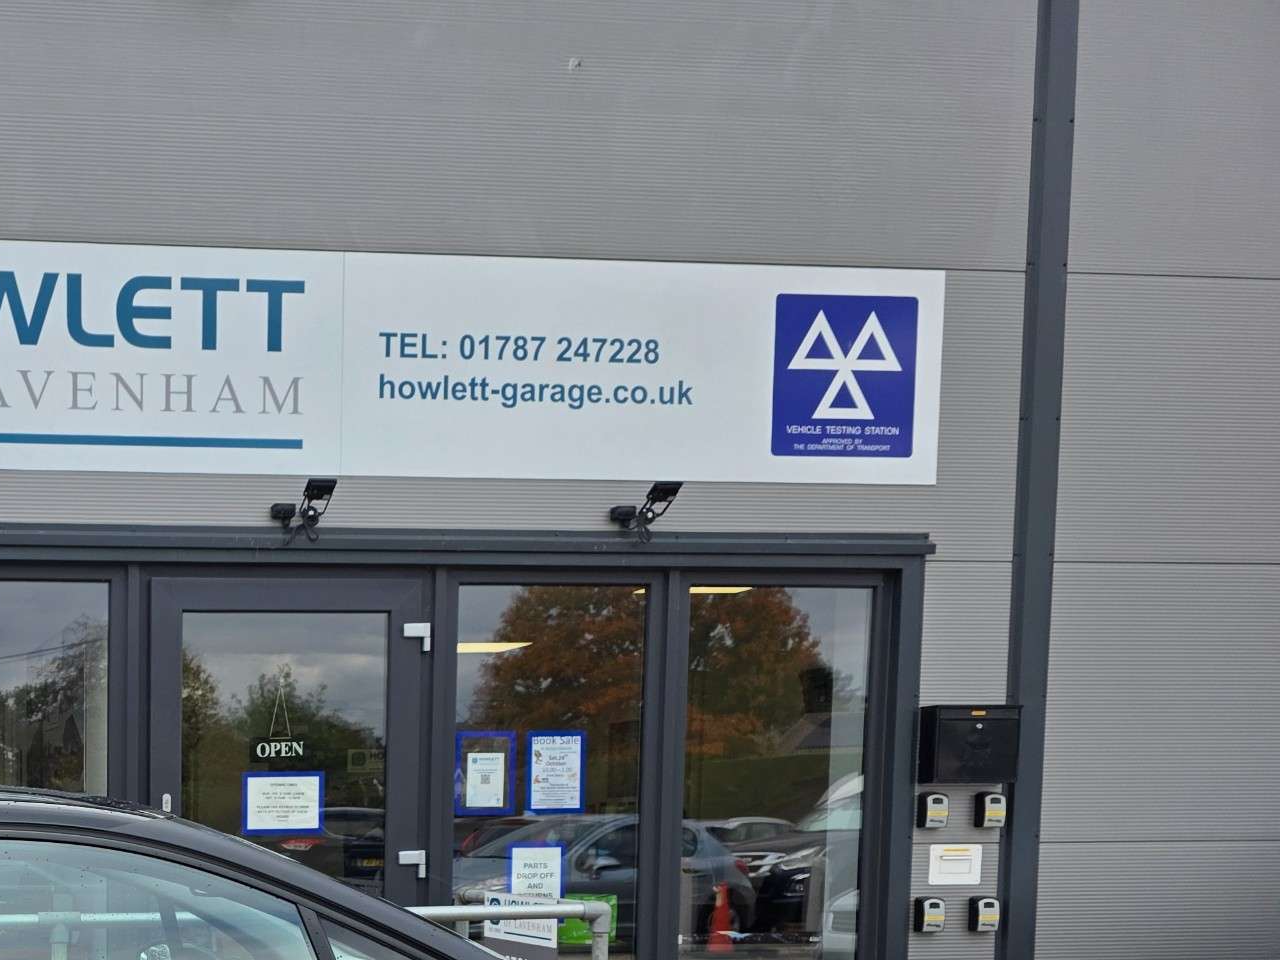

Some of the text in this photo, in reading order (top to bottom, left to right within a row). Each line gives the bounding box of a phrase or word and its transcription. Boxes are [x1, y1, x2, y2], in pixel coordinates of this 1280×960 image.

[379, 332, 660, 364] TEL: 01787 247228
[378, 373, 694, 410] howlett-garage.co.uk
[786, 425, 900, 436] VEHICLE TESTING STATION
[793, 443, 805, 451] THE
[256, 741, 304, 758] OPEN
[516, 872, 555, 880] DROP OFF
